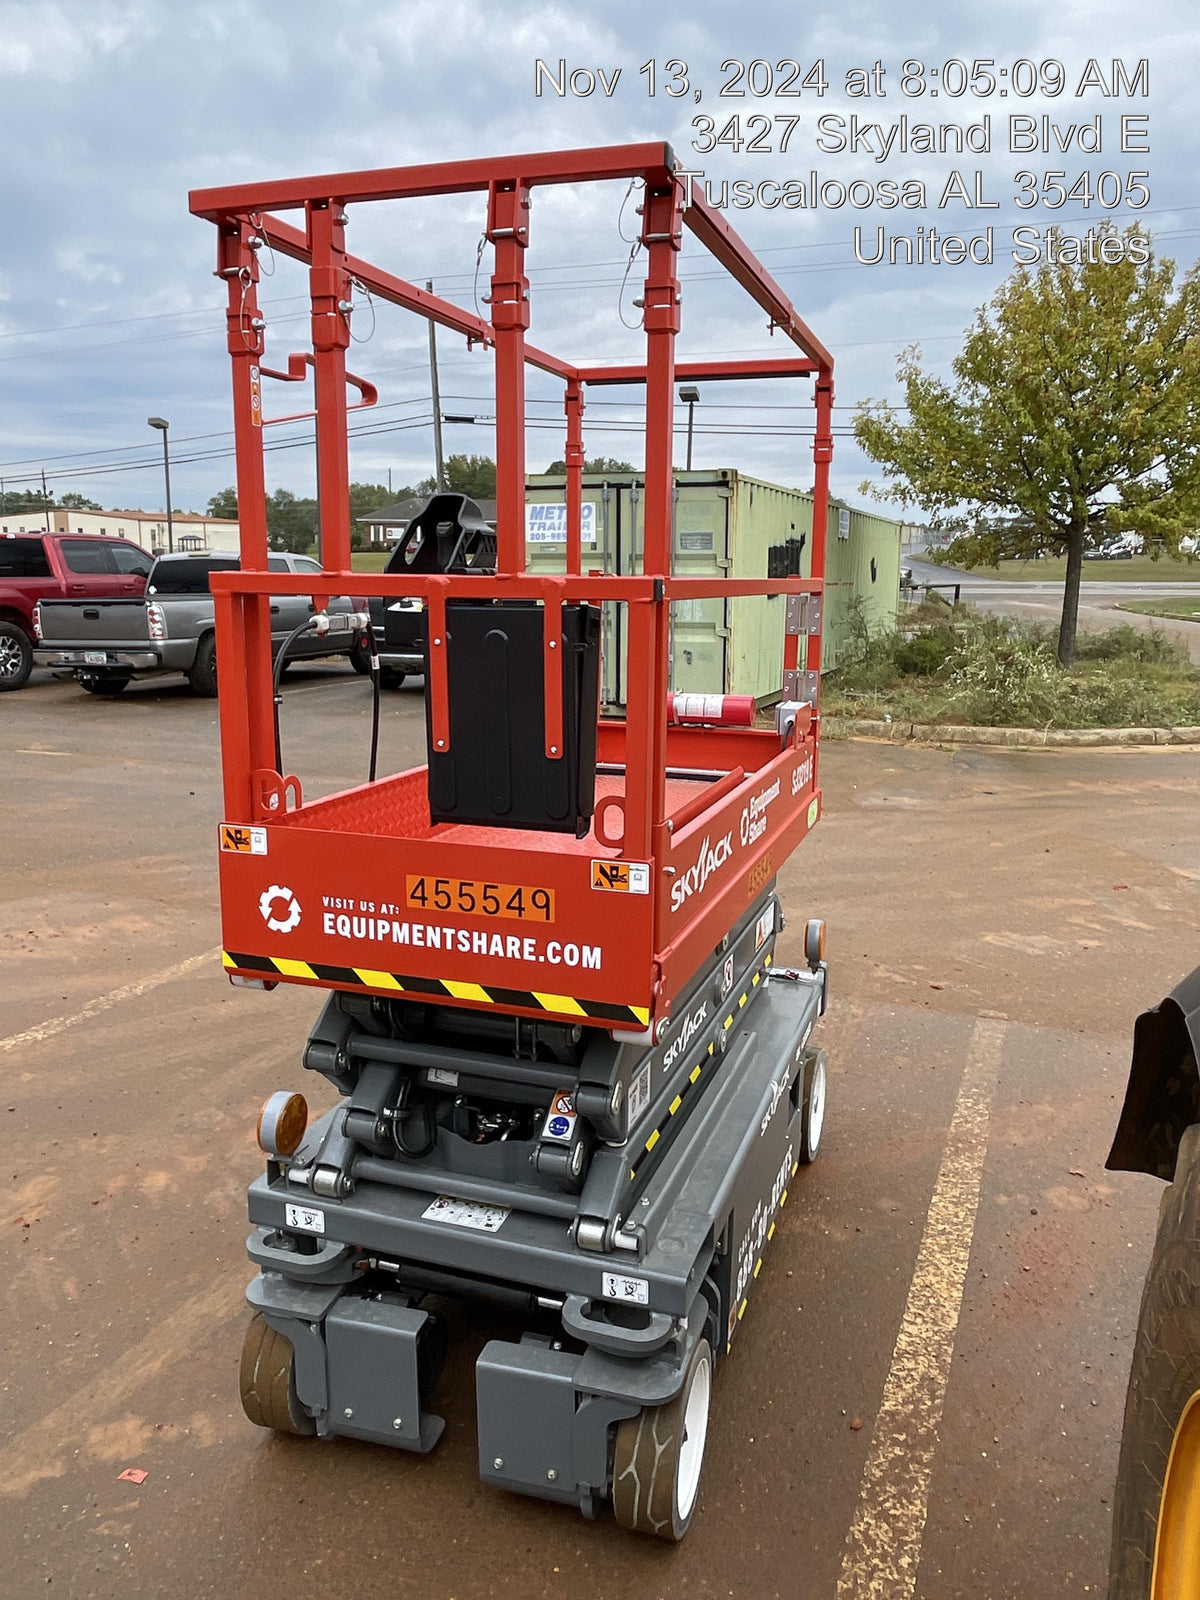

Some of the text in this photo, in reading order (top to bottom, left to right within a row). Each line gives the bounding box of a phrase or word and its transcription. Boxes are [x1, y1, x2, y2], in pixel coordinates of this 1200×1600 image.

[529, 504, 593, 521] METO
[749, 815, 767, 846] Share
[671, 830, 733, 913] SKYJACK
[322, 895, 400, 916] VISIT US AT:
[409, 877, 551, 921] 455549
[323, 912, 603, 970] EQUIPMENTSHARE.COM
[662, 1000, 708, 1073] SKYJACK
